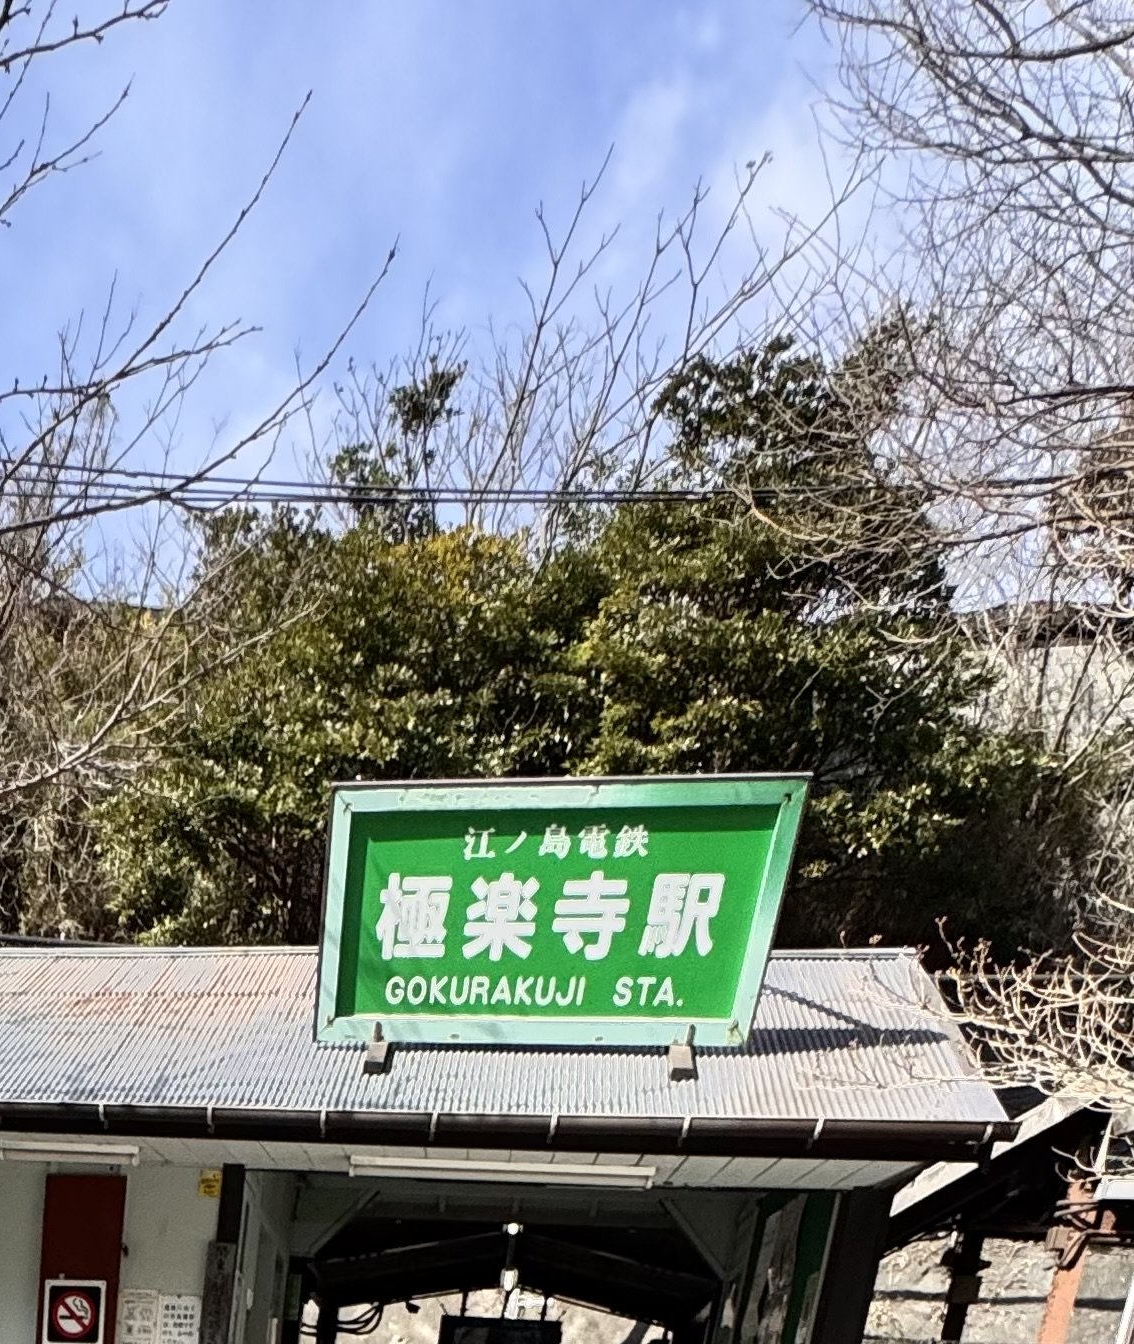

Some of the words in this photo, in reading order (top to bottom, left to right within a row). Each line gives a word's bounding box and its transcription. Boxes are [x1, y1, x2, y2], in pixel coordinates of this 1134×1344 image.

[462, 823, 651, 861] 江ノ島電鉄
[375, 870, 725, 962] 極楽寺駅
[384, 974, 587, 1007] GOKURAKUJI
[611, 975, 685, 1008] STA.
